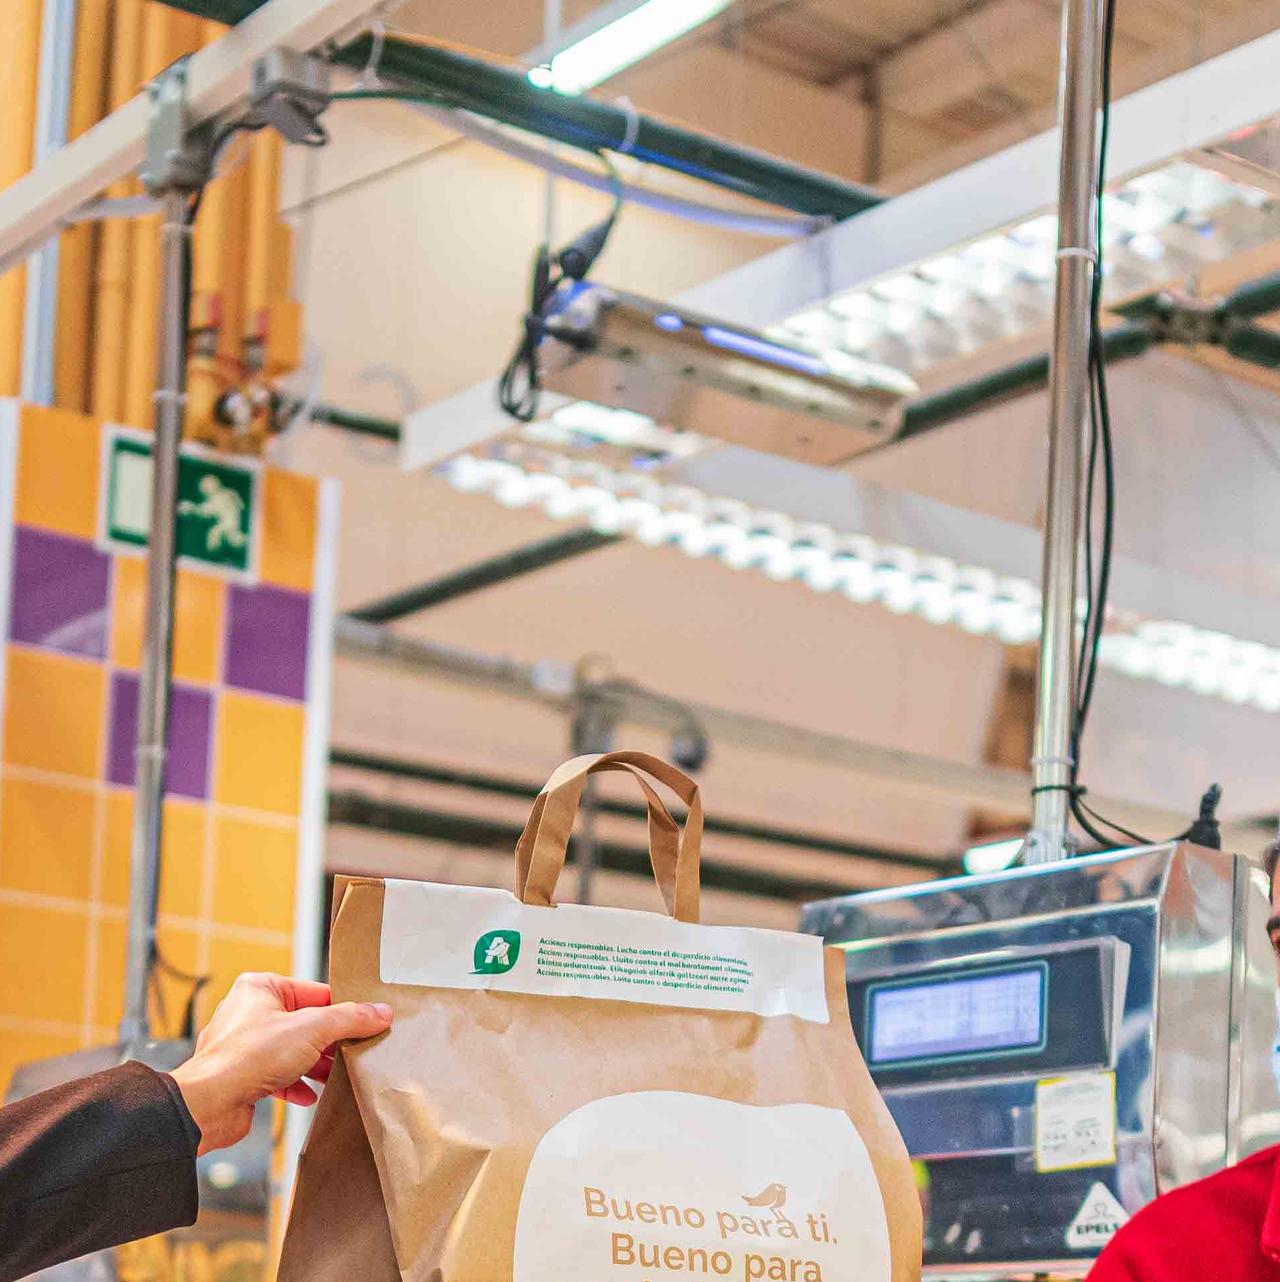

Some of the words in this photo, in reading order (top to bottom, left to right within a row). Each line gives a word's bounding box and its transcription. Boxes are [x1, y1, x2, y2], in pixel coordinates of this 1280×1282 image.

[540, 937, 566, 947] Acciones
[568, 942, 615, 953] responsables.
[617, 946, 638, 954] Lucha
[639, 949, 661, 957] contra
[671, 951, 710, 960] desperdicio
[563, 952, 610, 962] responsables.
[562, 972, 612, 981] responsables.
[662, 979, 702, 989] desperdicio
[703, 985, 744, 993] alimentario
[584, 1186, 705, 1229] Bueno
[716, 1207, 799, 1239] para
[806, 1212, 837, 1244] ti.
[611, 1232, 732, 1275] Bueno
